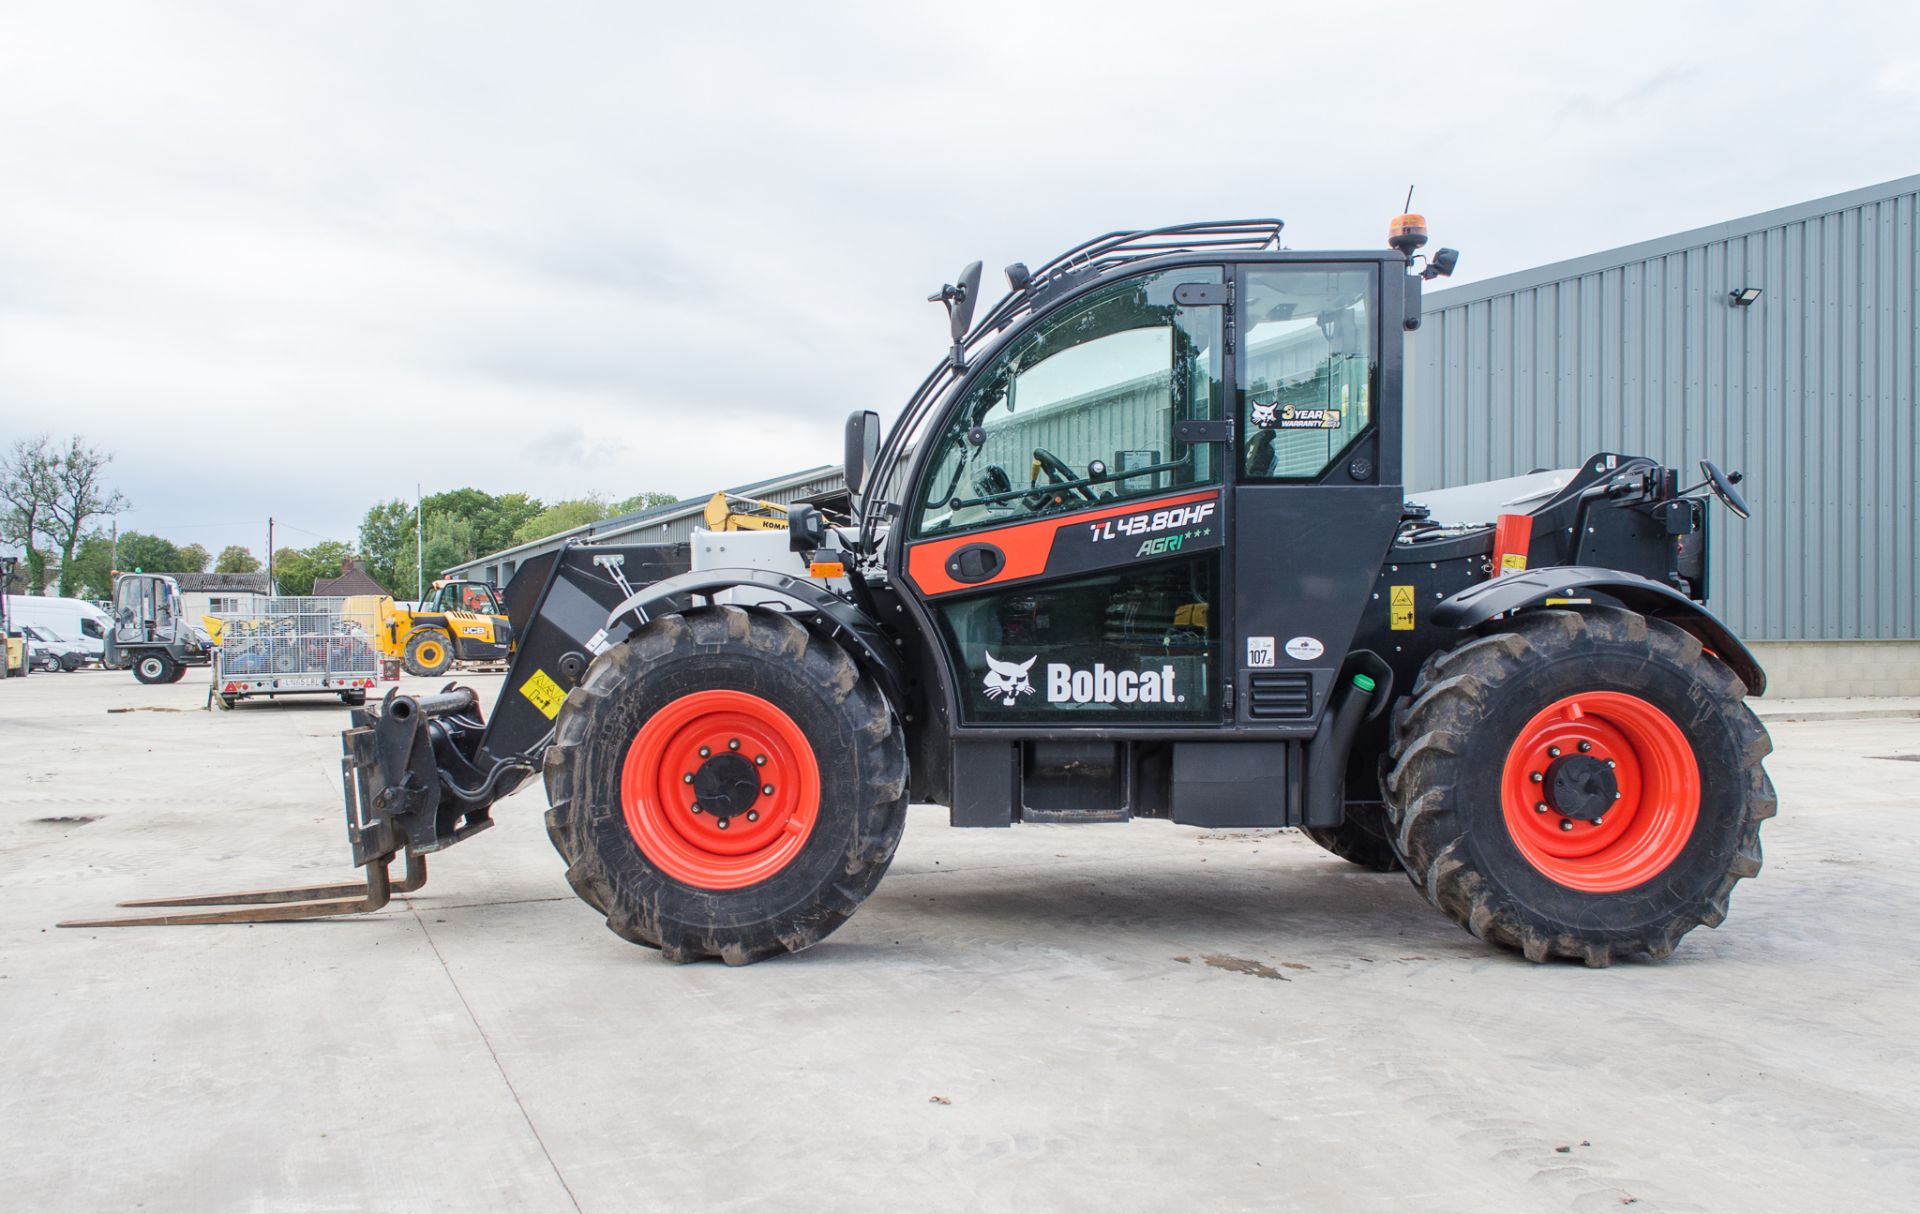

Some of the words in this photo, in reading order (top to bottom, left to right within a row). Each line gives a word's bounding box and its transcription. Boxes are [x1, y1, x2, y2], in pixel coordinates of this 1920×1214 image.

[1281, 420, 1322, 428] WARRANTY
[1135, 533, 1184, 558] AGRI
[463, 626, 486, 634] JCB
[1249, 649, 1268, 665] 107
[1047, 662, 1176, 704] Bobcat
